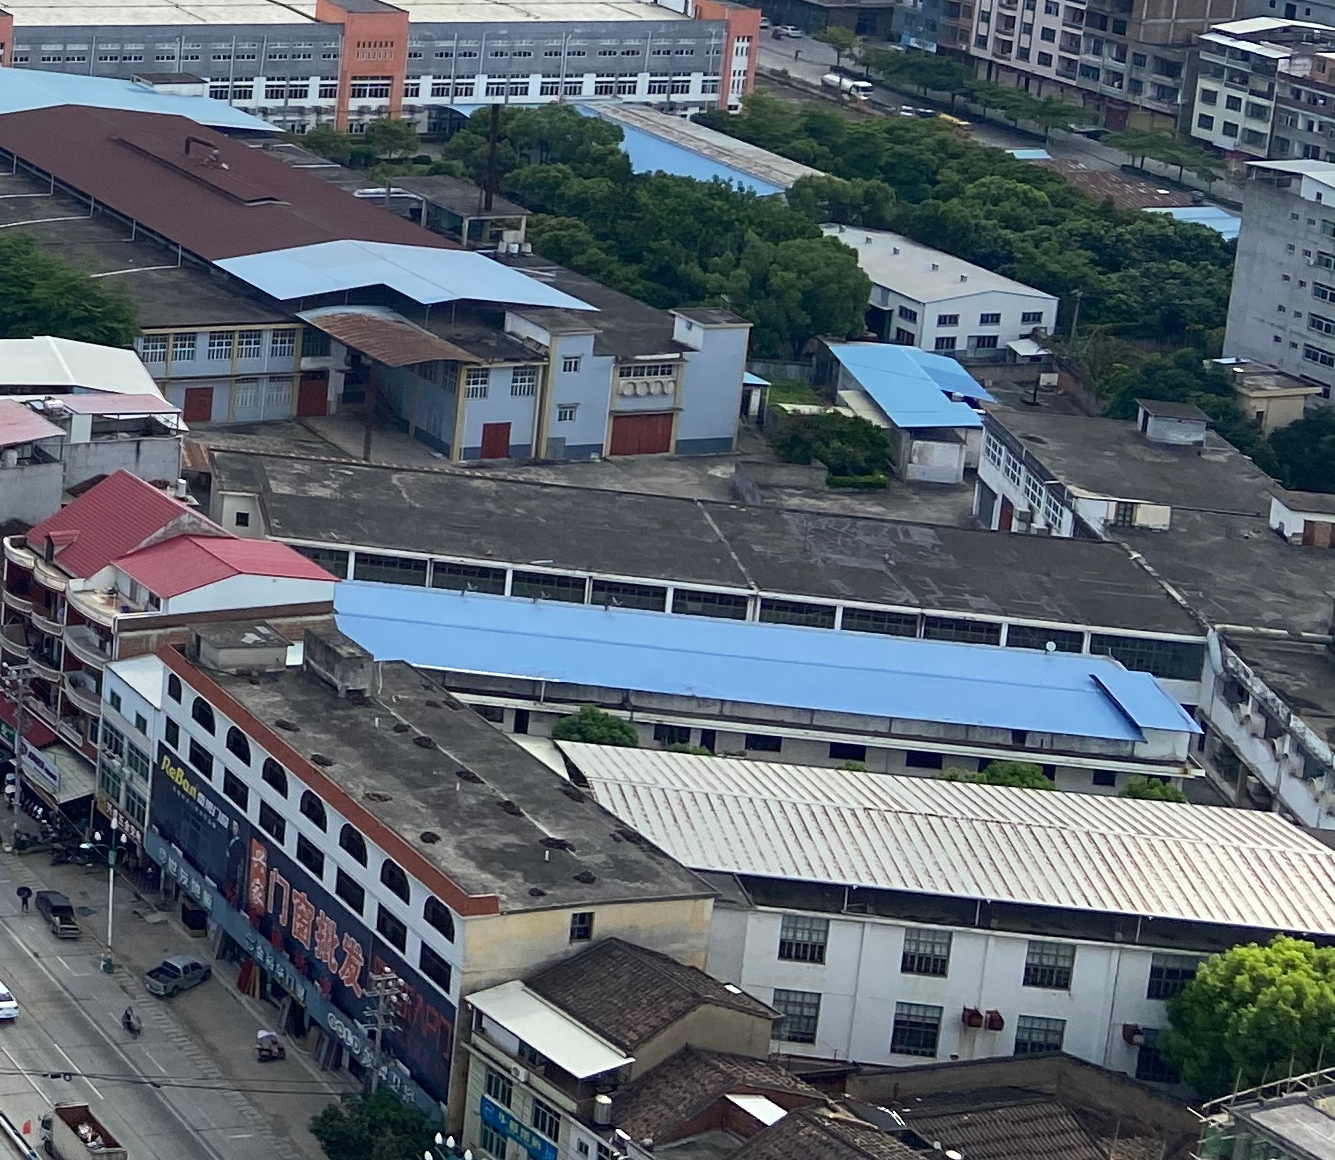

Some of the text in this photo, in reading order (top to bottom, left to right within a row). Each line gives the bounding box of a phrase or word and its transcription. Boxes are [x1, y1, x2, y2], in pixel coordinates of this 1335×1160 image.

[161, 754, 198, 800] ReBan
[267, 866, 365, 999] 门窗批发
